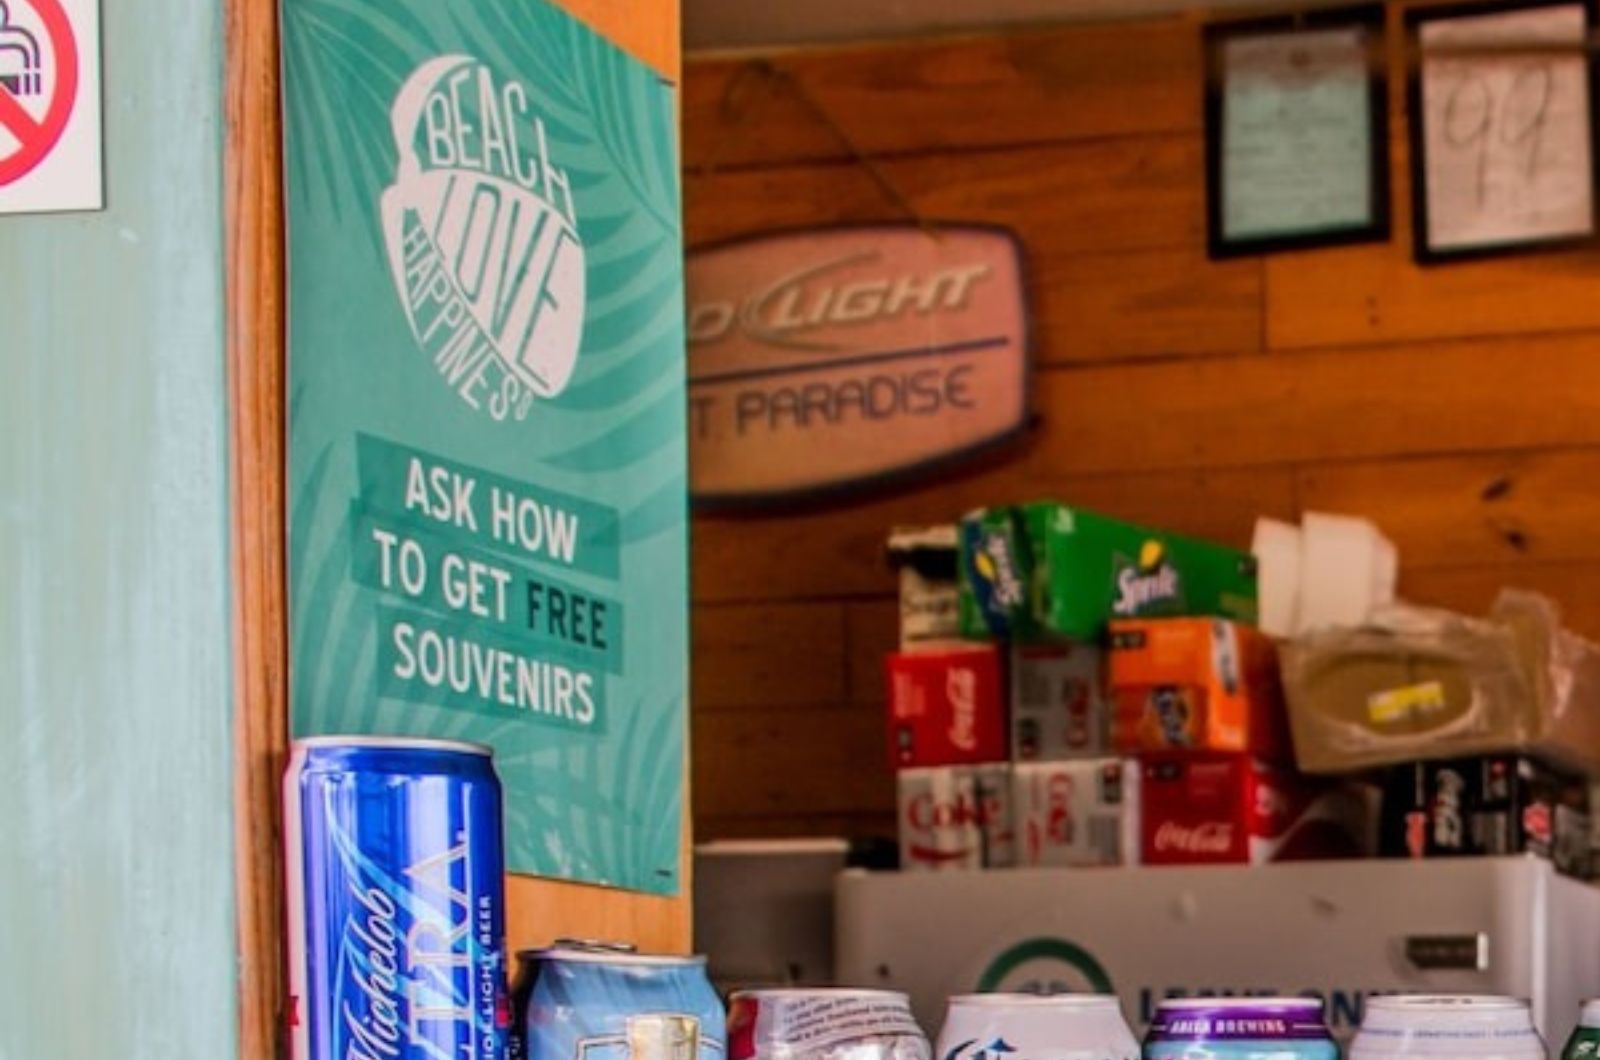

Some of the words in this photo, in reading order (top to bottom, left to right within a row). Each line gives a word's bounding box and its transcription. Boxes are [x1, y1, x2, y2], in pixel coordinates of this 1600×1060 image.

[424, 65, 578, 228] BEACH
[400, 222, 533, 422] HAPPINESS
[430, 172, 582, 394] LOVE
[769, 264, 990, 330] LIGHT
[736, 364, 976, 436] PARADISE
[405, 457, 477, 533] ASK
[492, 487, 577, 564] HOW
[372, 527, 427, 596] TO
[442, 554, 512, 623] GET
[526, 579, 608, 651] FREE
[393, 622, 595, 725] SOUVENIRS
[478, 896, 493, 946] BEER
[479, 952, 499, 1015] LIGHT
